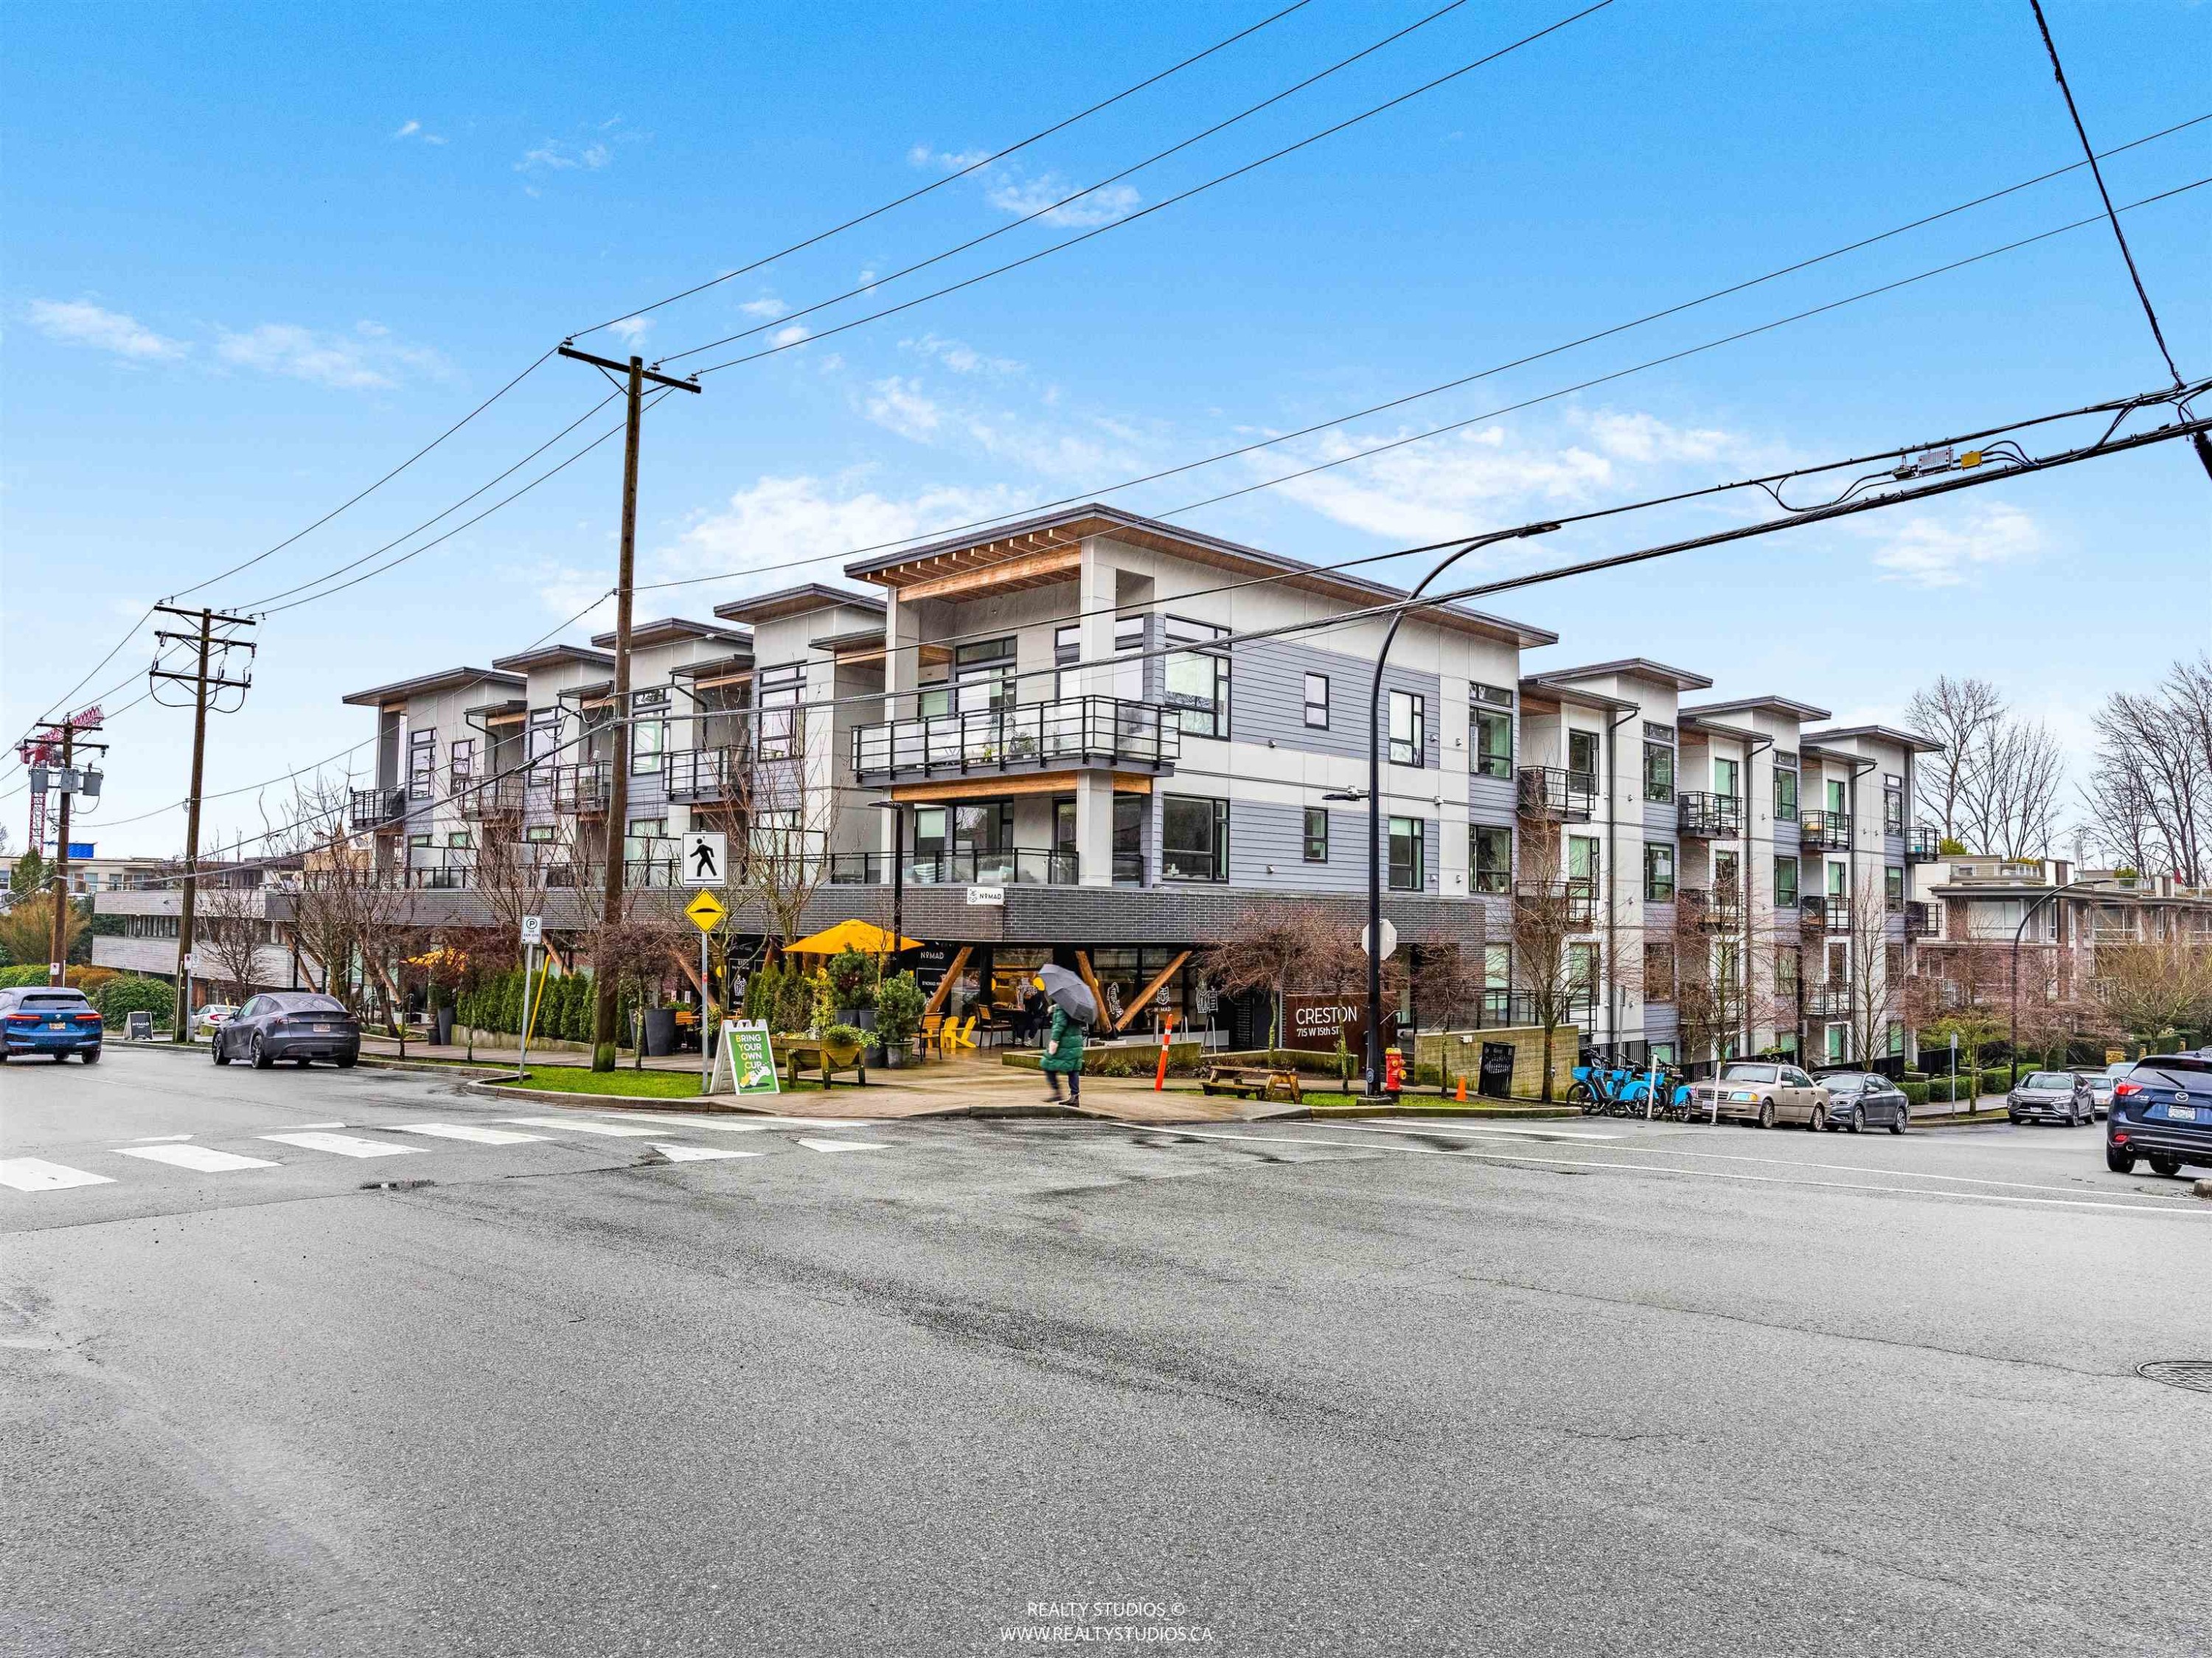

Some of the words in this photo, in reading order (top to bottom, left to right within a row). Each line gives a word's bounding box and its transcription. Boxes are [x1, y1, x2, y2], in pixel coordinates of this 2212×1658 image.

[1295, 1006, 1357, 1025] CRESTON
[1296, 1028, 1308, 1037] 715
[1308, 1027, 1317, 1037] W
[1317, 1026, 1331, 1036] 15th
[1331, 1025, 1340, 1035] ST
[735, 1034, 762, 1042] BRING
[738, 1043, 762, 1052] YOUR
[740, 1052, 763, 1060] OWN
[744, 1061, 762, 1069] CUP
